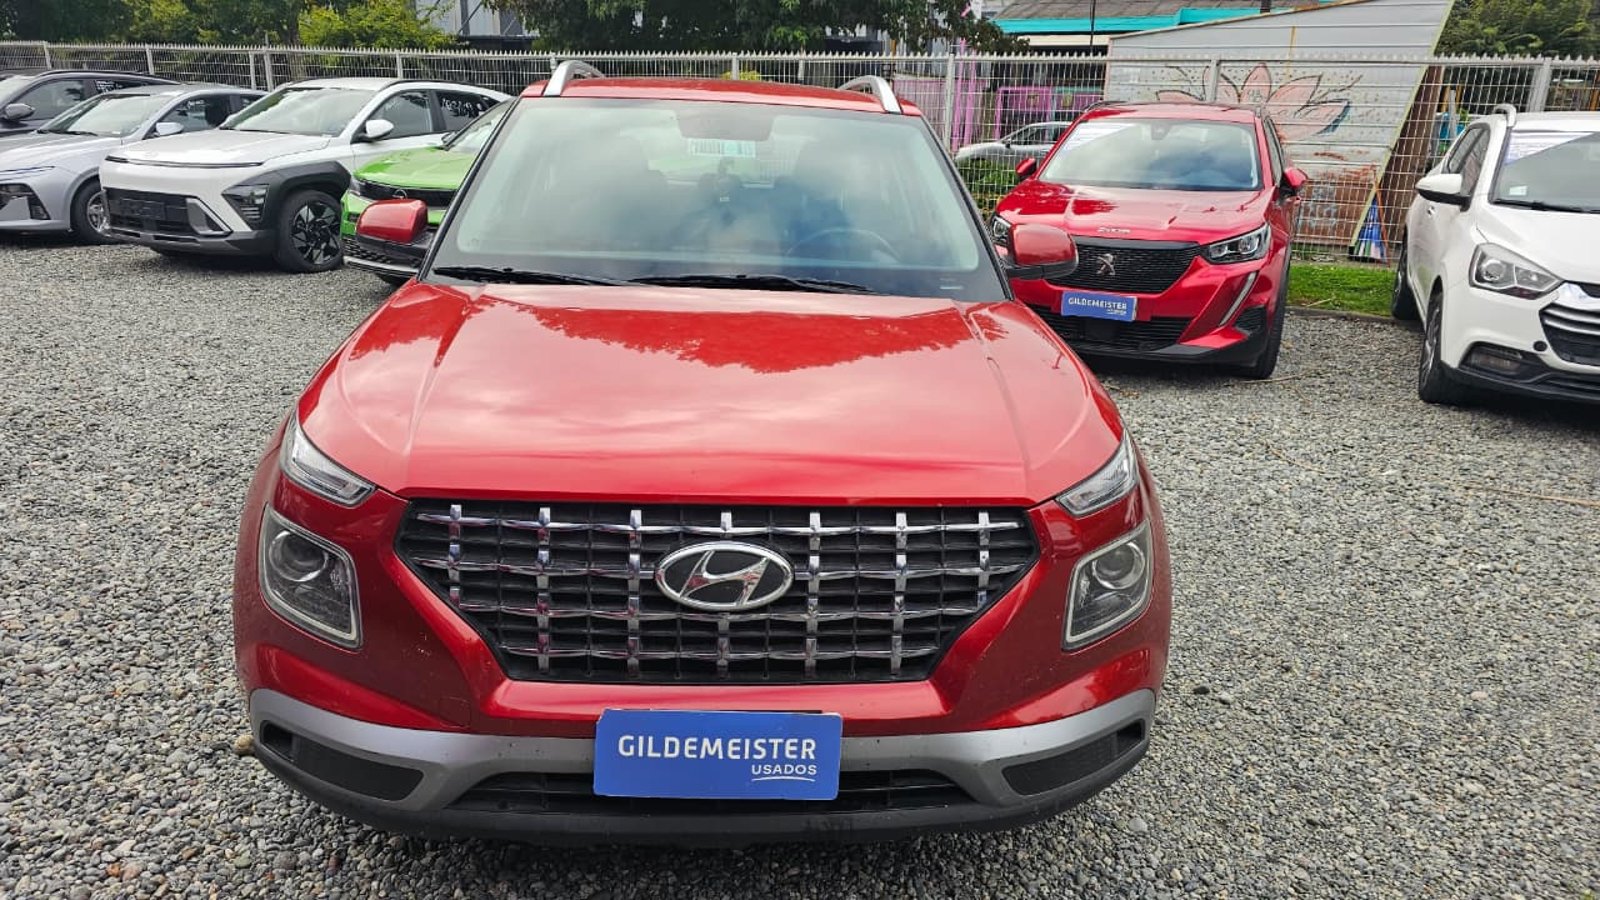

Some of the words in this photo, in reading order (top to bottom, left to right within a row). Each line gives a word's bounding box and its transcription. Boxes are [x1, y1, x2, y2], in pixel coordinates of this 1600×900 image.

[1068, 297, 1127, 309] GILDEMEISTER
[618, 735, 817, 760] GILDEMEISTER
[751, 764, 818, 776] USADOS
